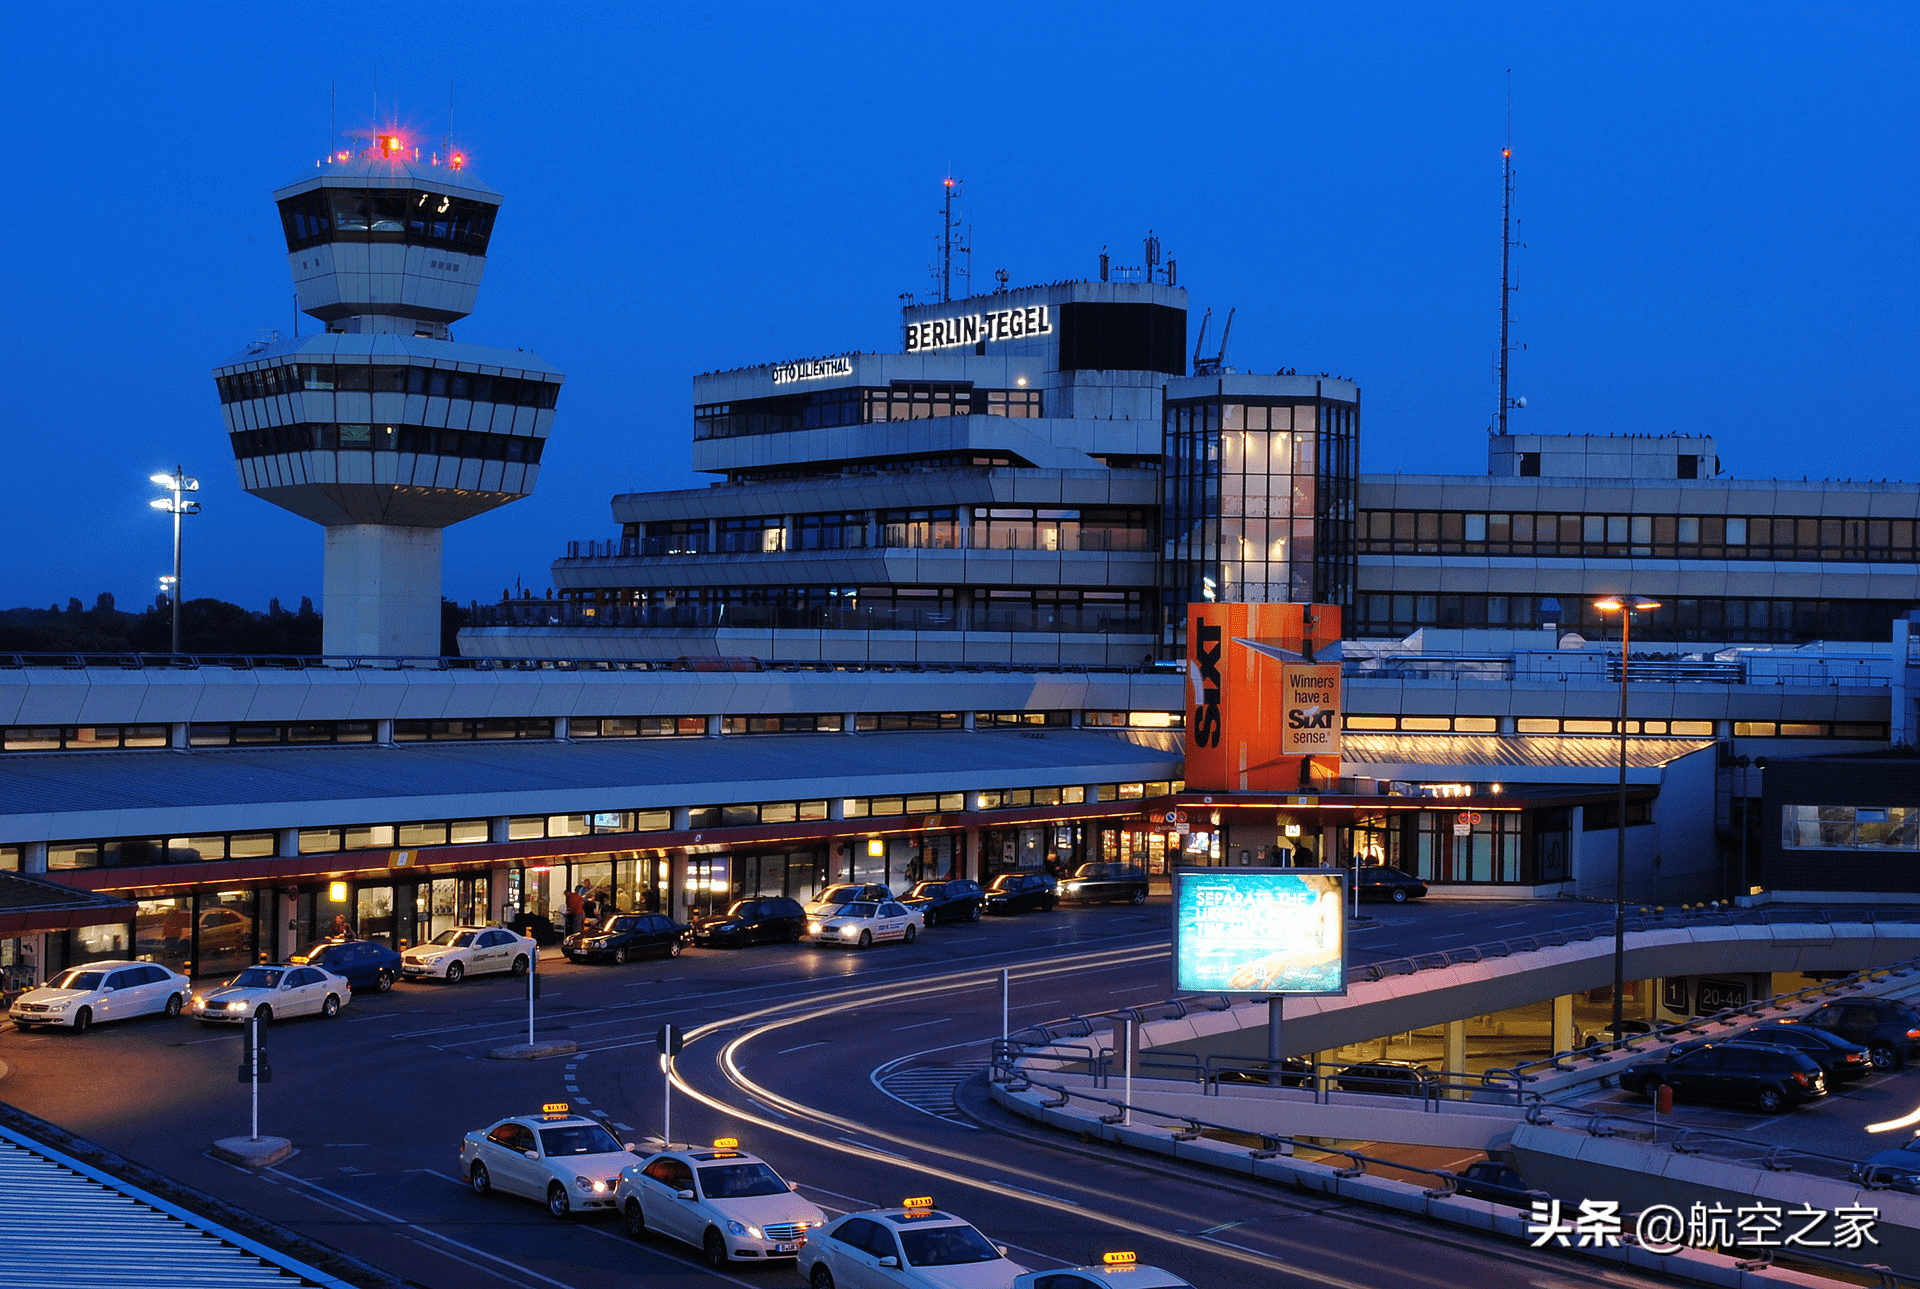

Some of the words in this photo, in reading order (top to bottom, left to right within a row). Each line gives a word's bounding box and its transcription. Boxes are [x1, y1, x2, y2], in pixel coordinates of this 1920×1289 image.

[906, 305, 1052, 351] BERLIN-TEGEL
[772, 362, 797, 383] OTTO
[1192, 617, 1222, 748] SIXT
[1290, 674, 1334, 688] Winners
[1294, 690, 1318, 704] have
[1322, 692, 1330, 704] a
[1670, 984, 1676, 1000] 1
[1703, 988, 1744, 1008] 20-44
